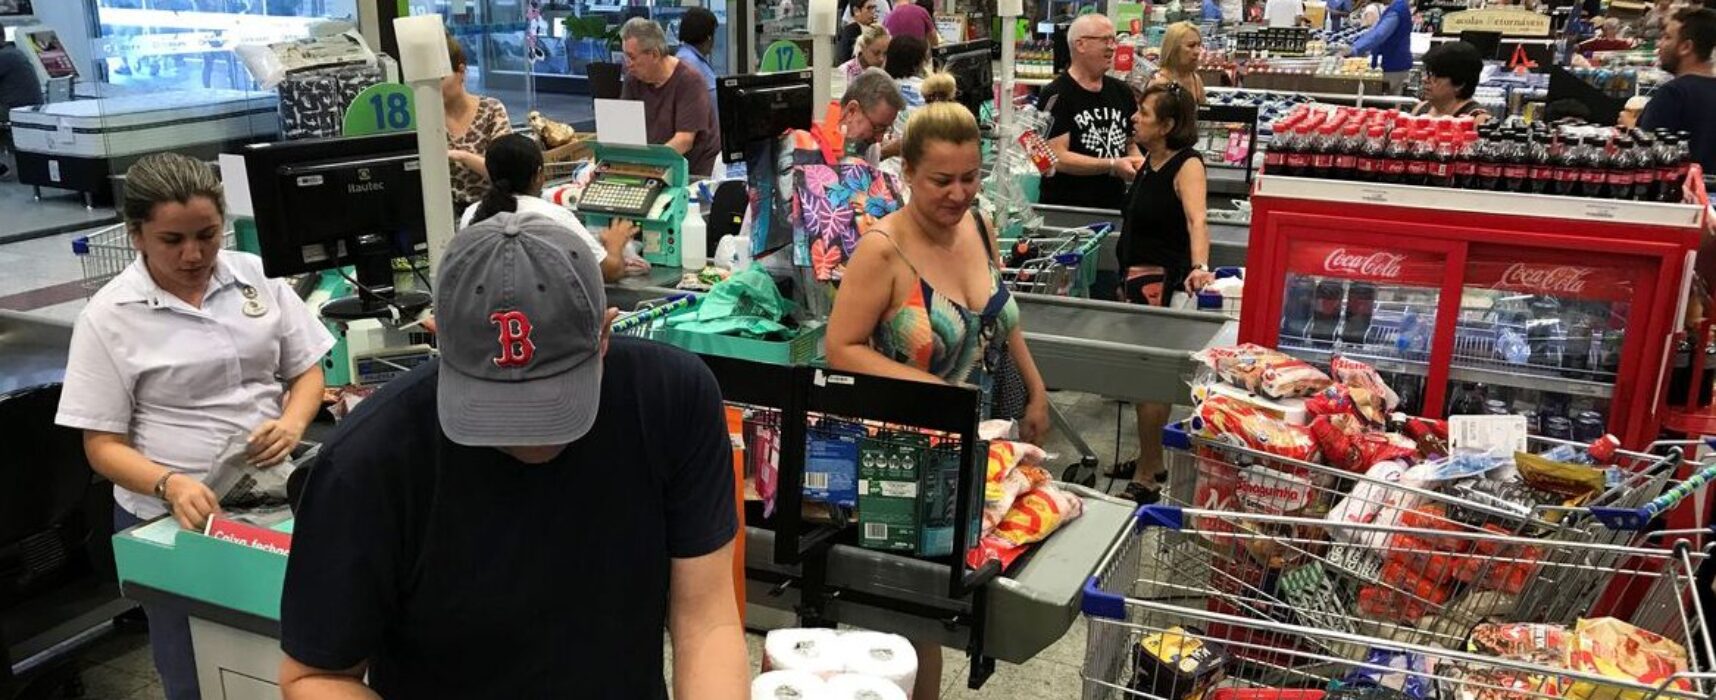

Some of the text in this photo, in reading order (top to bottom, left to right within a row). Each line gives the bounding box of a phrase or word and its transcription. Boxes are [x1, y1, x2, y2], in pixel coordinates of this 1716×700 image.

[776, 46, 794, 71] 17
[369, 92, 411, 130] 18
[1324, 248, 1407, 278] Coca-Cola
[1501, 263, 1591, 291] Coca-Cola
[490, 310, 536, 367] B
